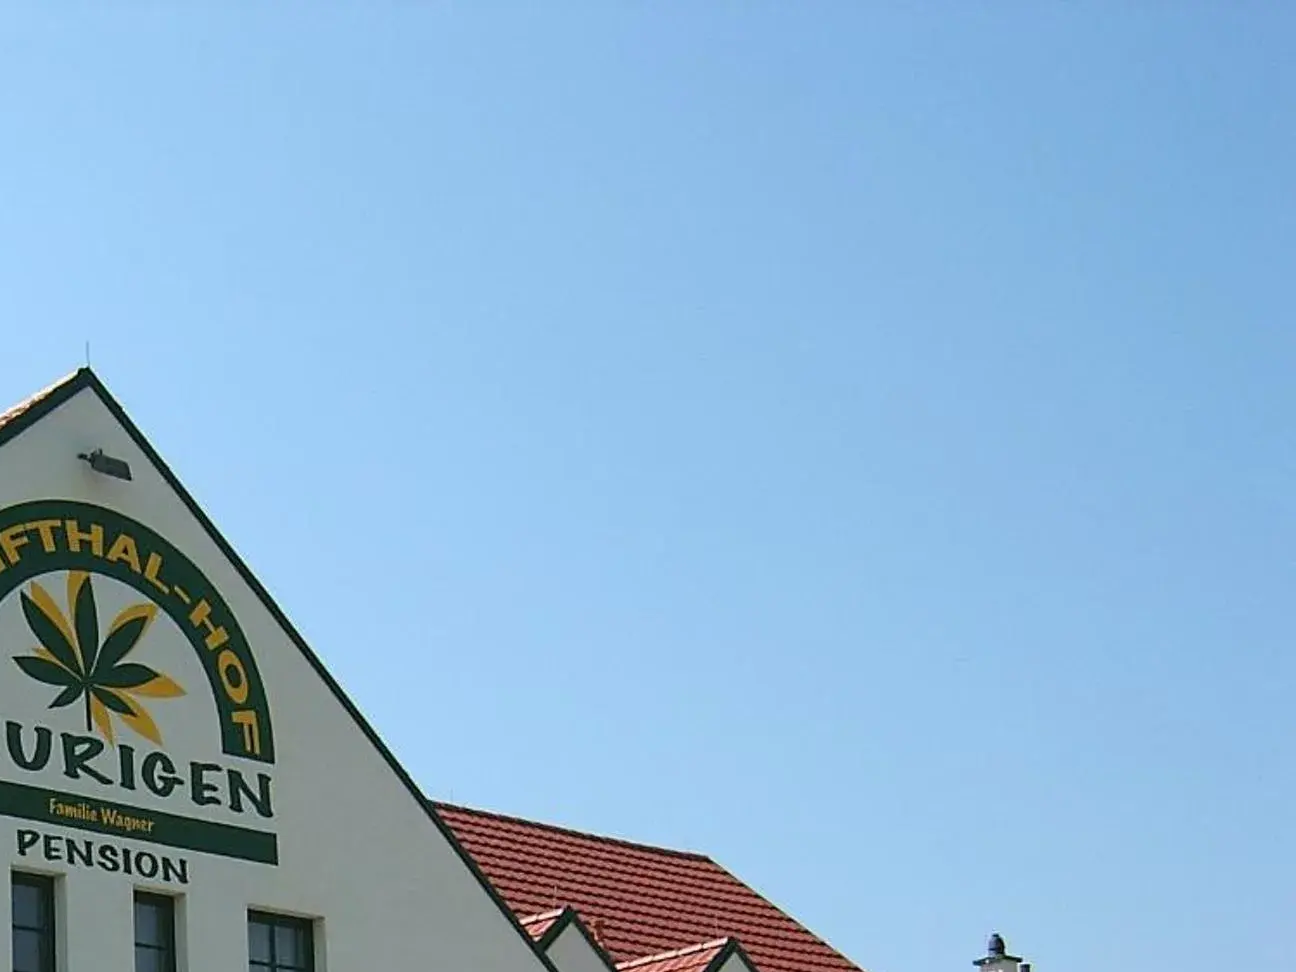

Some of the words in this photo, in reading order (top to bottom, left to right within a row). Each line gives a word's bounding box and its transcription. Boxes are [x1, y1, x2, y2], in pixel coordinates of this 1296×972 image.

[48, 798, 98, 822] Familie
[100, 807, 155, 833] Wagner
[16, 829, 190, 884] PENSION
